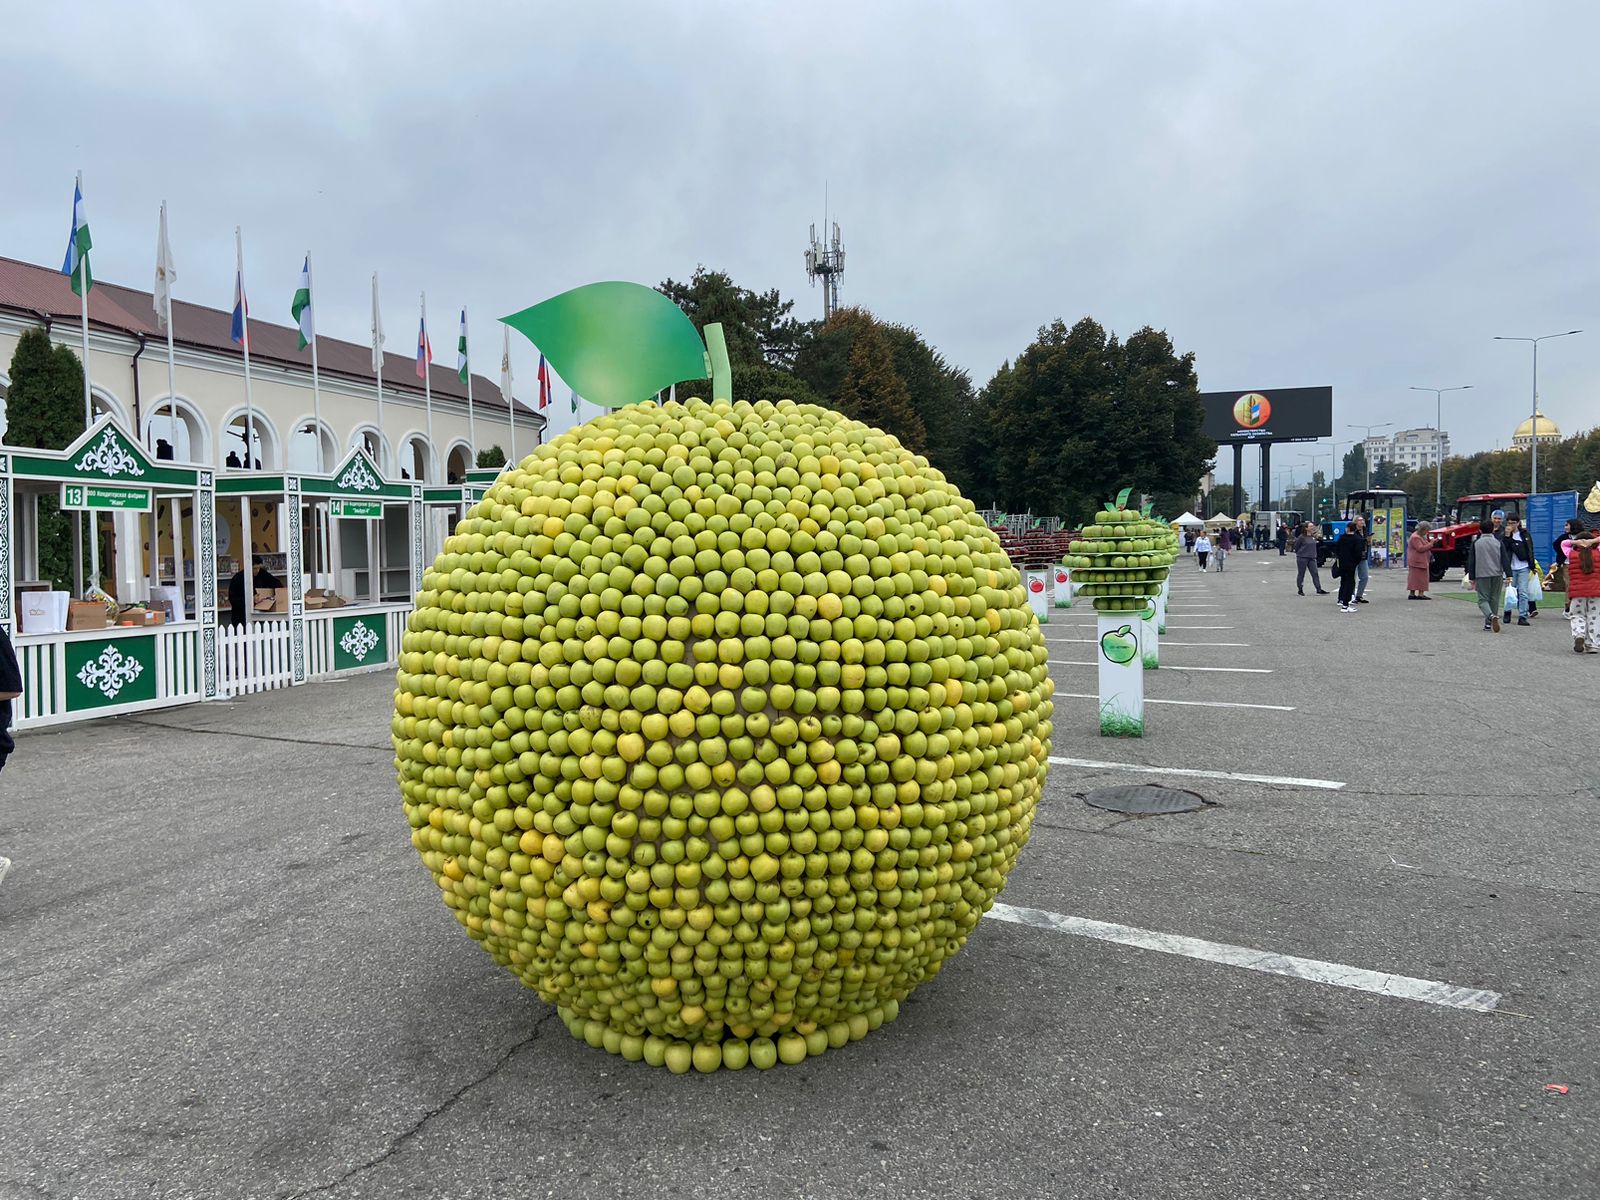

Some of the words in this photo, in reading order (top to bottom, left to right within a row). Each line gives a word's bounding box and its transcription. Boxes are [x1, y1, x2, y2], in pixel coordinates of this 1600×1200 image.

[67, 488, 82, 505] 13
[96, 490, 127, 499] Кондитерская
[127, 492, 146, 500] фабрика
[332, 501, 340, 513] 14
